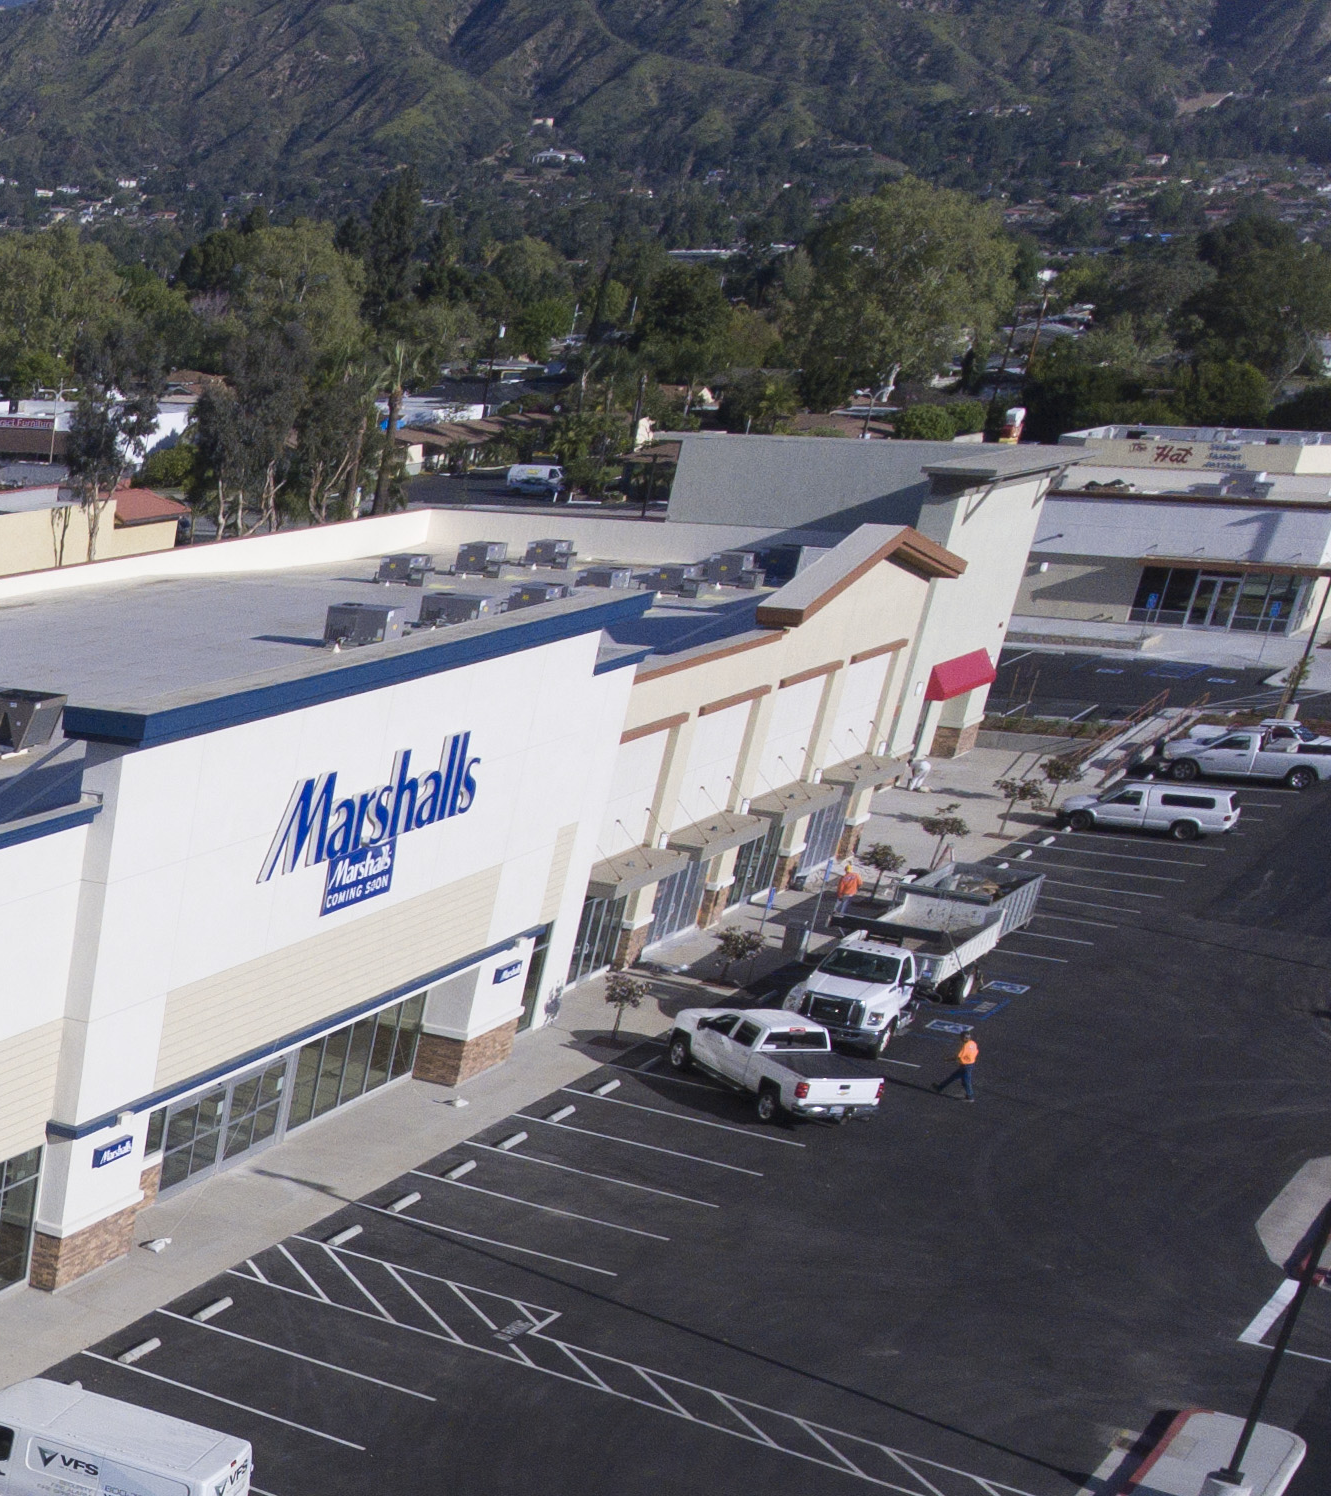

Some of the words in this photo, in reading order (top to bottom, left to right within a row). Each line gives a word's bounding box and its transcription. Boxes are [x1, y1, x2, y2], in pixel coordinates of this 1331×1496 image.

[1154, 444, 1194, 464] Hat
[256, 730, 481, 885] Marshalls
[326, 884, 364, 909] COMING
[60, 1454, 99, 1476] VFS
